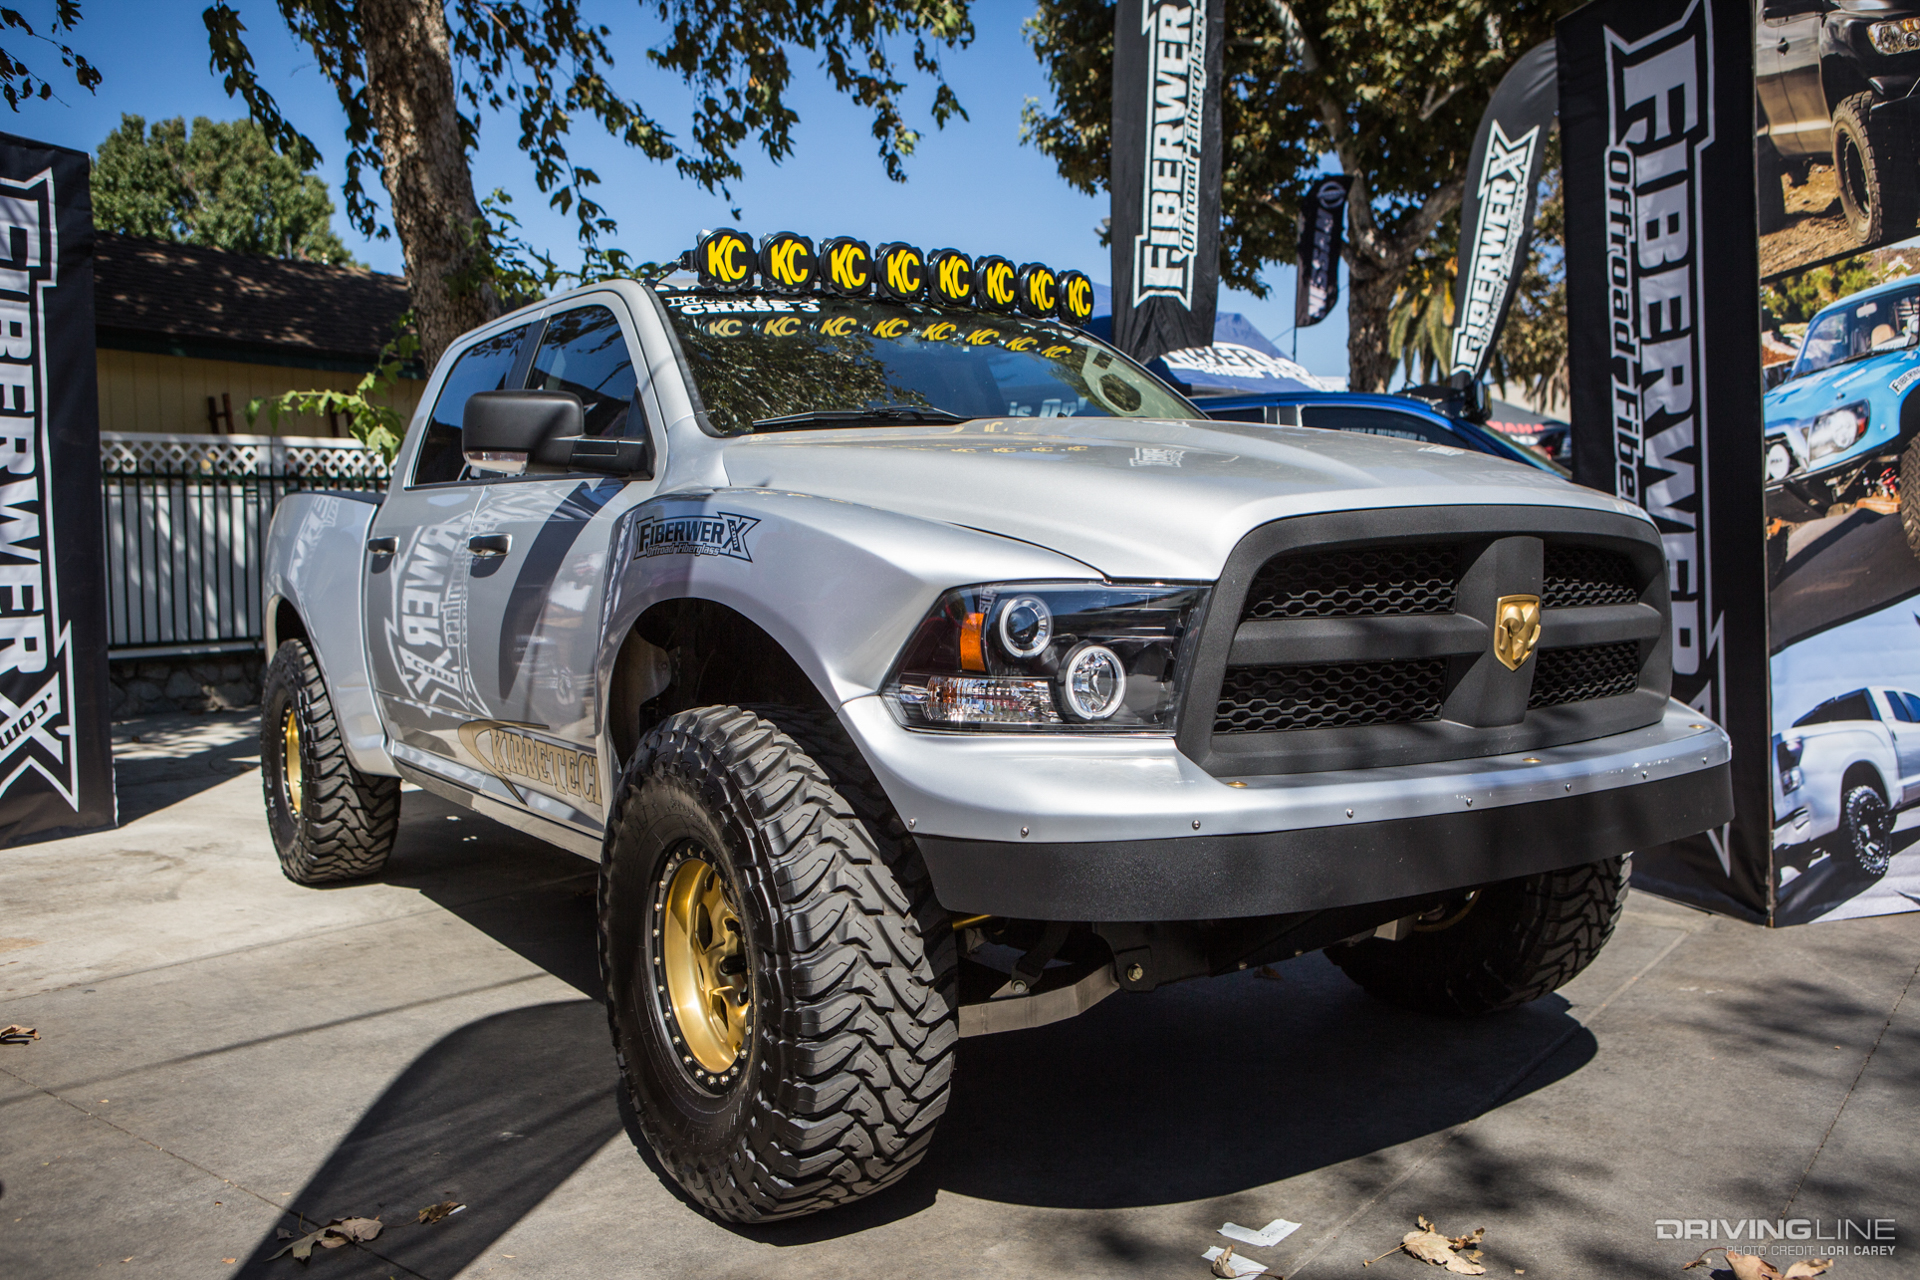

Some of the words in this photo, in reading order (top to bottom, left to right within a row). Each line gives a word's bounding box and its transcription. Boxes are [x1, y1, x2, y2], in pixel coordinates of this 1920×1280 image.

[708, 236, 747, 282] KC
[771, 240, 809, 285] KC
[831, 245, 867, 289] KC
[888, 250, 920, 294] KC
[1457, 141, 1528, 367] FIBERWERX
[940, 257, 970, 299] KC
[987, 263, 1015, 305] KC
[1030, 270, 1055, 311] KC
[1069, 278, 1091, 317] KC
[638, 519, 748, 553] FIBERWERX
